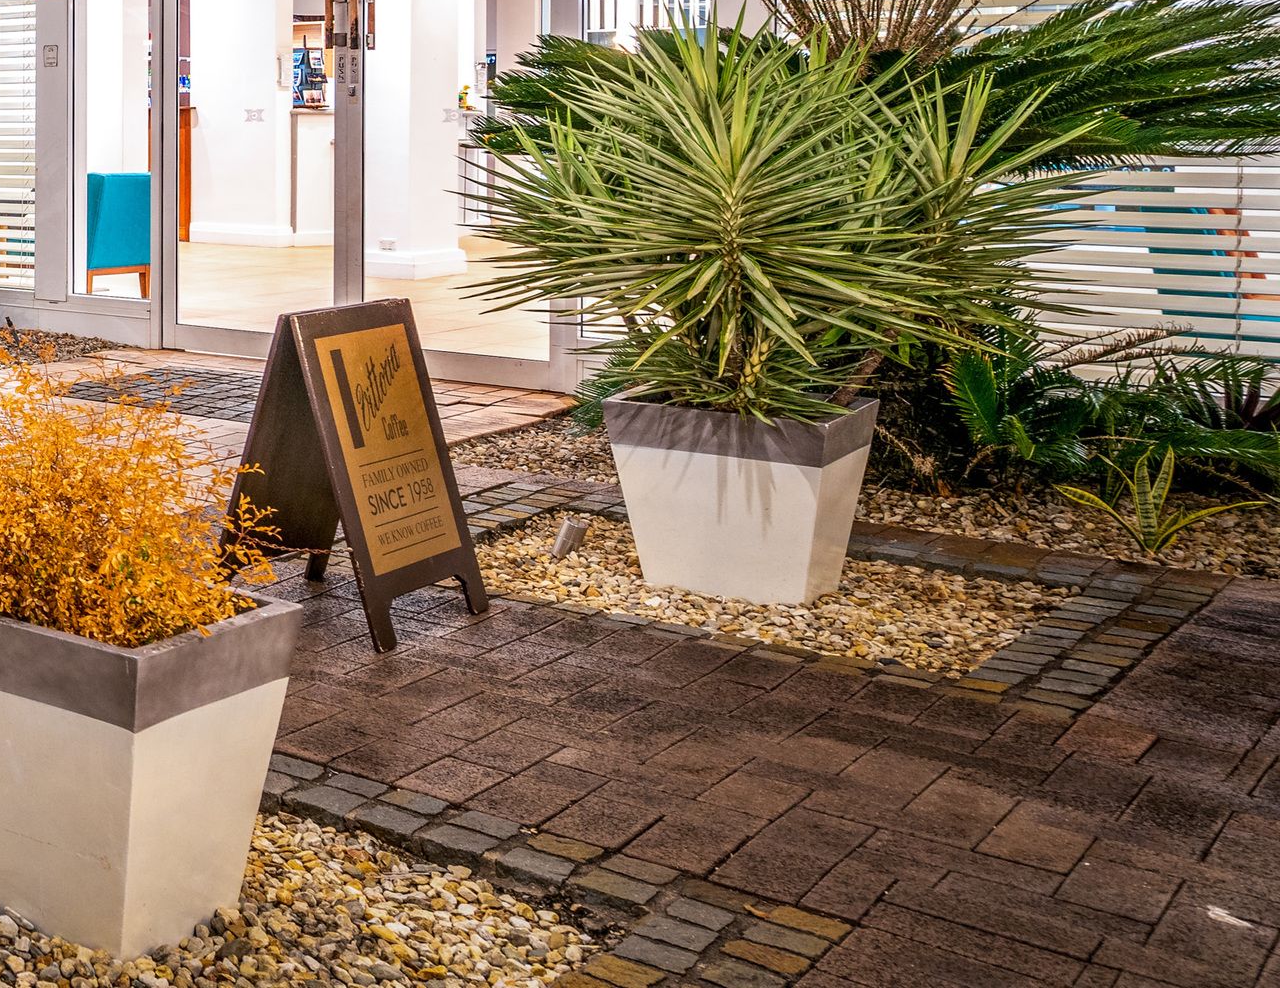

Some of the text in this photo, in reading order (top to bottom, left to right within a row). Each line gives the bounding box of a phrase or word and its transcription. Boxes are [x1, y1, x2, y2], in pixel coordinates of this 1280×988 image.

[355, 343, 401, 432] Vittoria
[381, 413, 409, 441] Coffee
[361, 457, 429, 489] FAMILY OWNED
[367, 477, 434, 516] SINCE 1958
[377, 515, 444, 546] WE KNOW COFFEE
